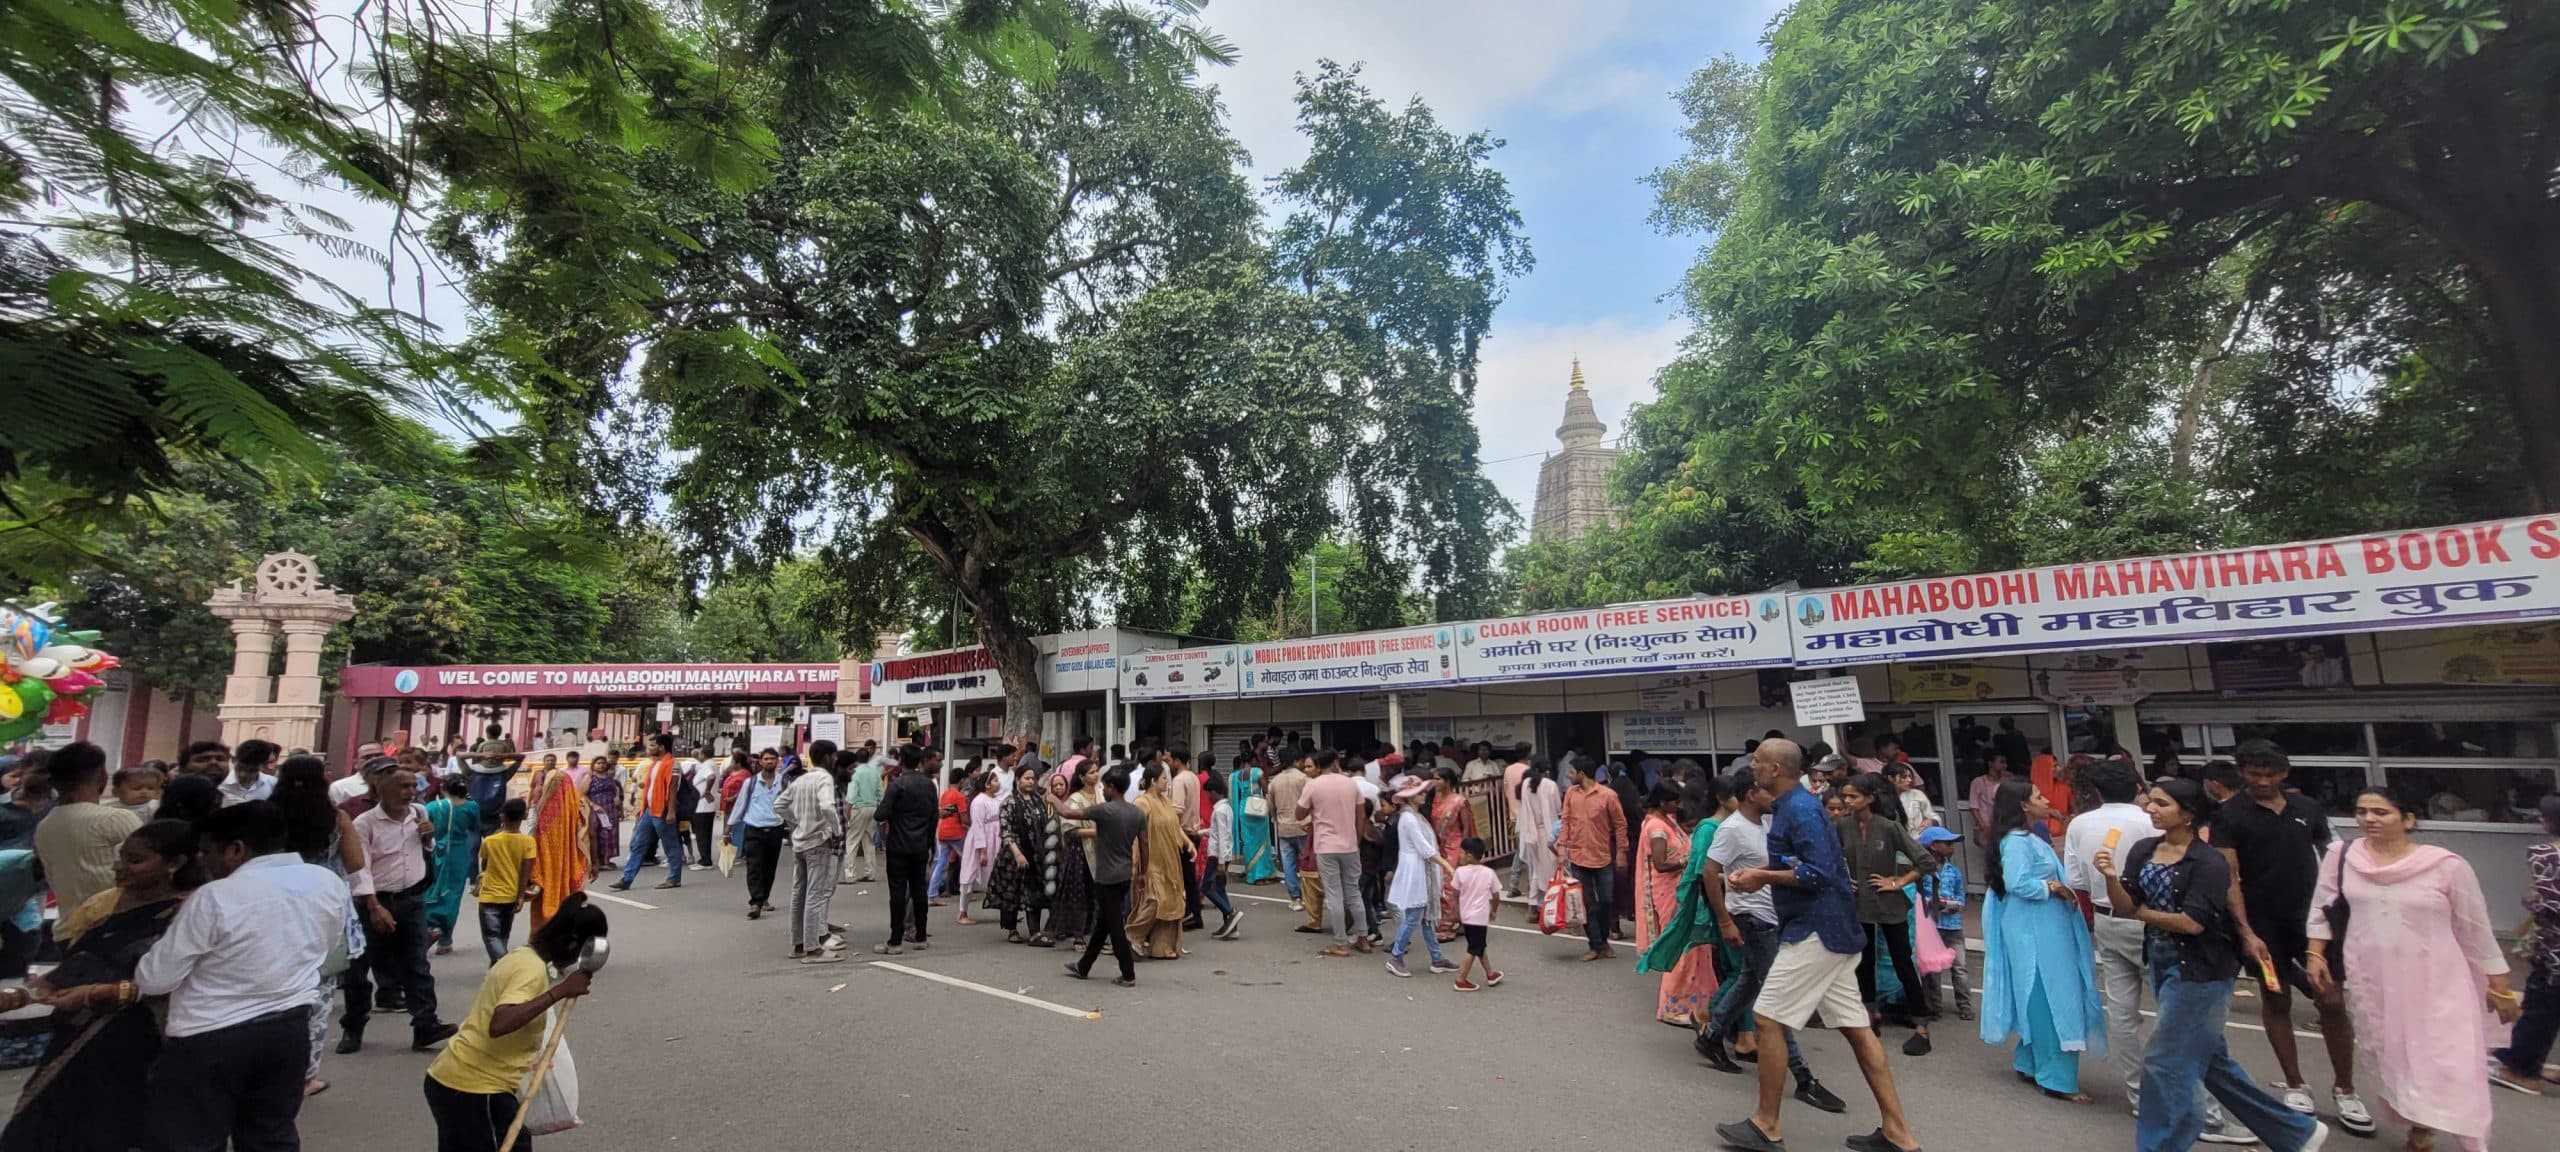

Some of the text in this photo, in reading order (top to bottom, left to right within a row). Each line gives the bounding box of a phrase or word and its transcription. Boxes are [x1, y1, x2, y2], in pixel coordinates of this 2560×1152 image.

[1831, 571, 2040, 622] MAHABODHI
[2054, 543, 2347, 602] MAHAVIHARA
[2359, 525, 2512, 575] BOOK
[1479, 600, 1751, 639] CLOAK ROOM (FREE SERVICE)
[1803, 574, 2539, 651] महाबोधी महाविहार बुक
[1255, 635, 1434, 664] MOBILE PHONE DEPOSIT COUNTER (FREE SERVICE)
[1479, 640, 1542, 659] अमांती
[1548, 640, 1578, 653] घर
[1695, 621, 1757, 645] सेवा)
[1145, 651, 1208, 663] CAMERA TICKET COUNTER
[1261, 668, 1297, 685] मोबाइल
[1298, 669, 1318, 681] जमा
[1407, 657, 1429, 674] सेवा
[1540, 660, 1577, 669] अपना
[1582, 656, 1627, 667] सामान
[1663, 652, 1697, 661] जमा
[544, 671, 568, 685] TO
[572, 670, 681, 684] MAHABODHI
[685, 669, 796, 683] MAHAVIHARA
[650, 682, 711, 691] HERITAGE
